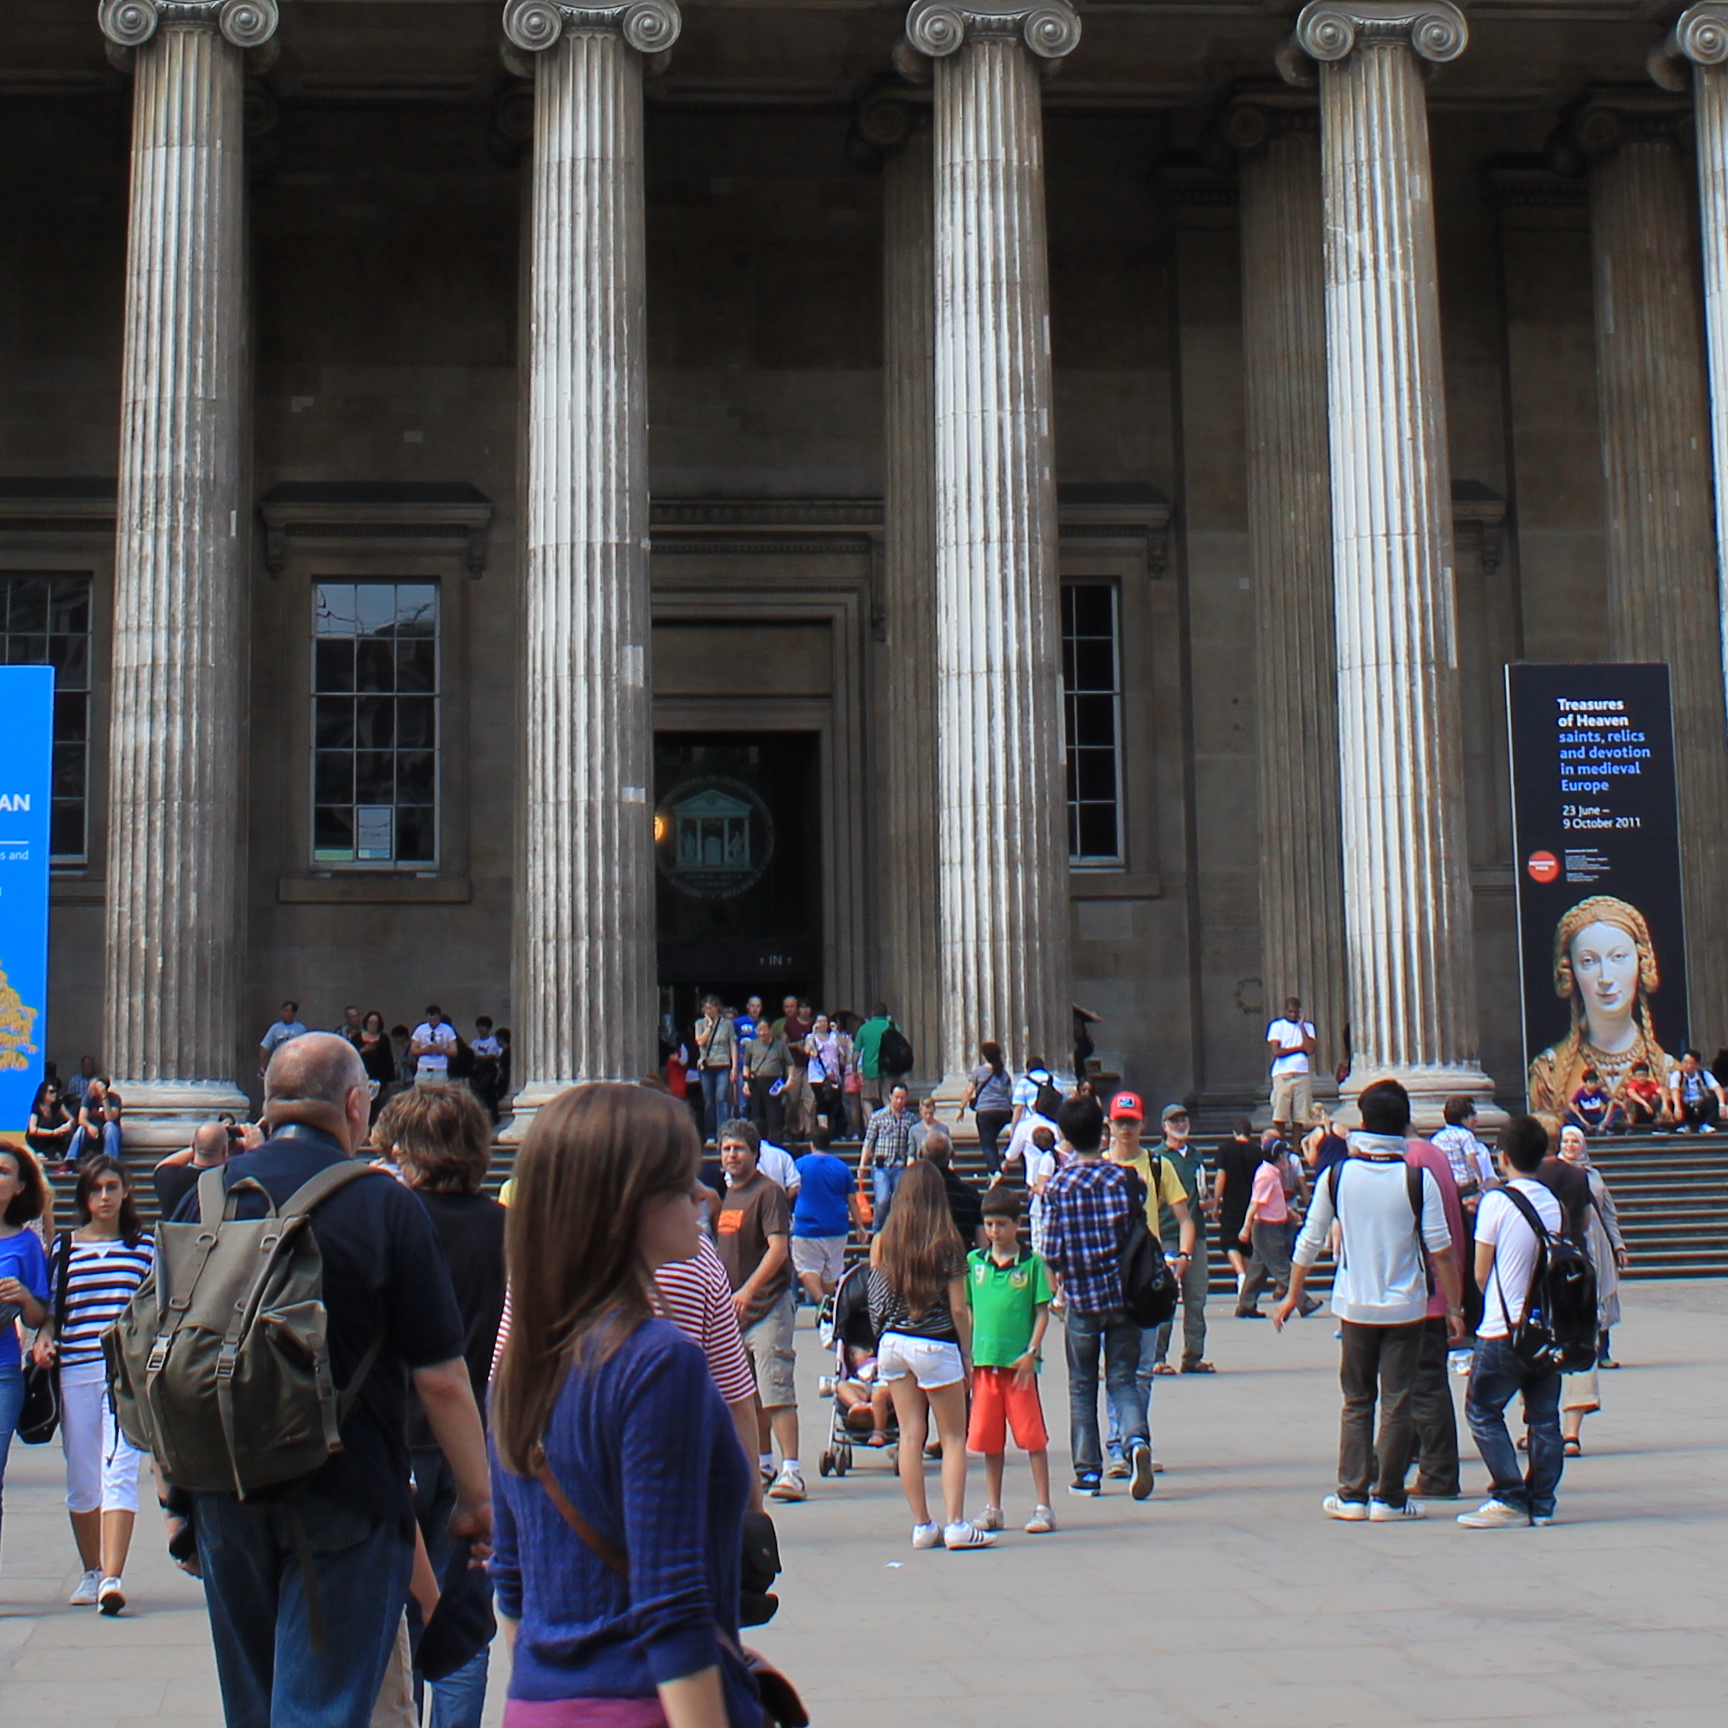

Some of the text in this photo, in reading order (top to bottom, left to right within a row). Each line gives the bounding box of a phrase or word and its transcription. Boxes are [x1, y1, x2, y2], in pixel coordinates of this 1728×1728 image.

[1556, 697, 1625, 711] Treasures
[1558, 713, 1629, 727] of Heaven
[1559, 729, 1645, 744] saints, relics
[1560, 745, 1651, 759] and devotion
[1560, 761, 1641, 775] in medieval
[1561, 779, 1609, 795] Europe
[1562, 805, 1577, 816] 23
[1578, 805, 1601, 818] June
[1563, 816, 1641, 829] 9 October 2011
[9, 849, 29, 860] and
[769, 955, 782, 966] IN
